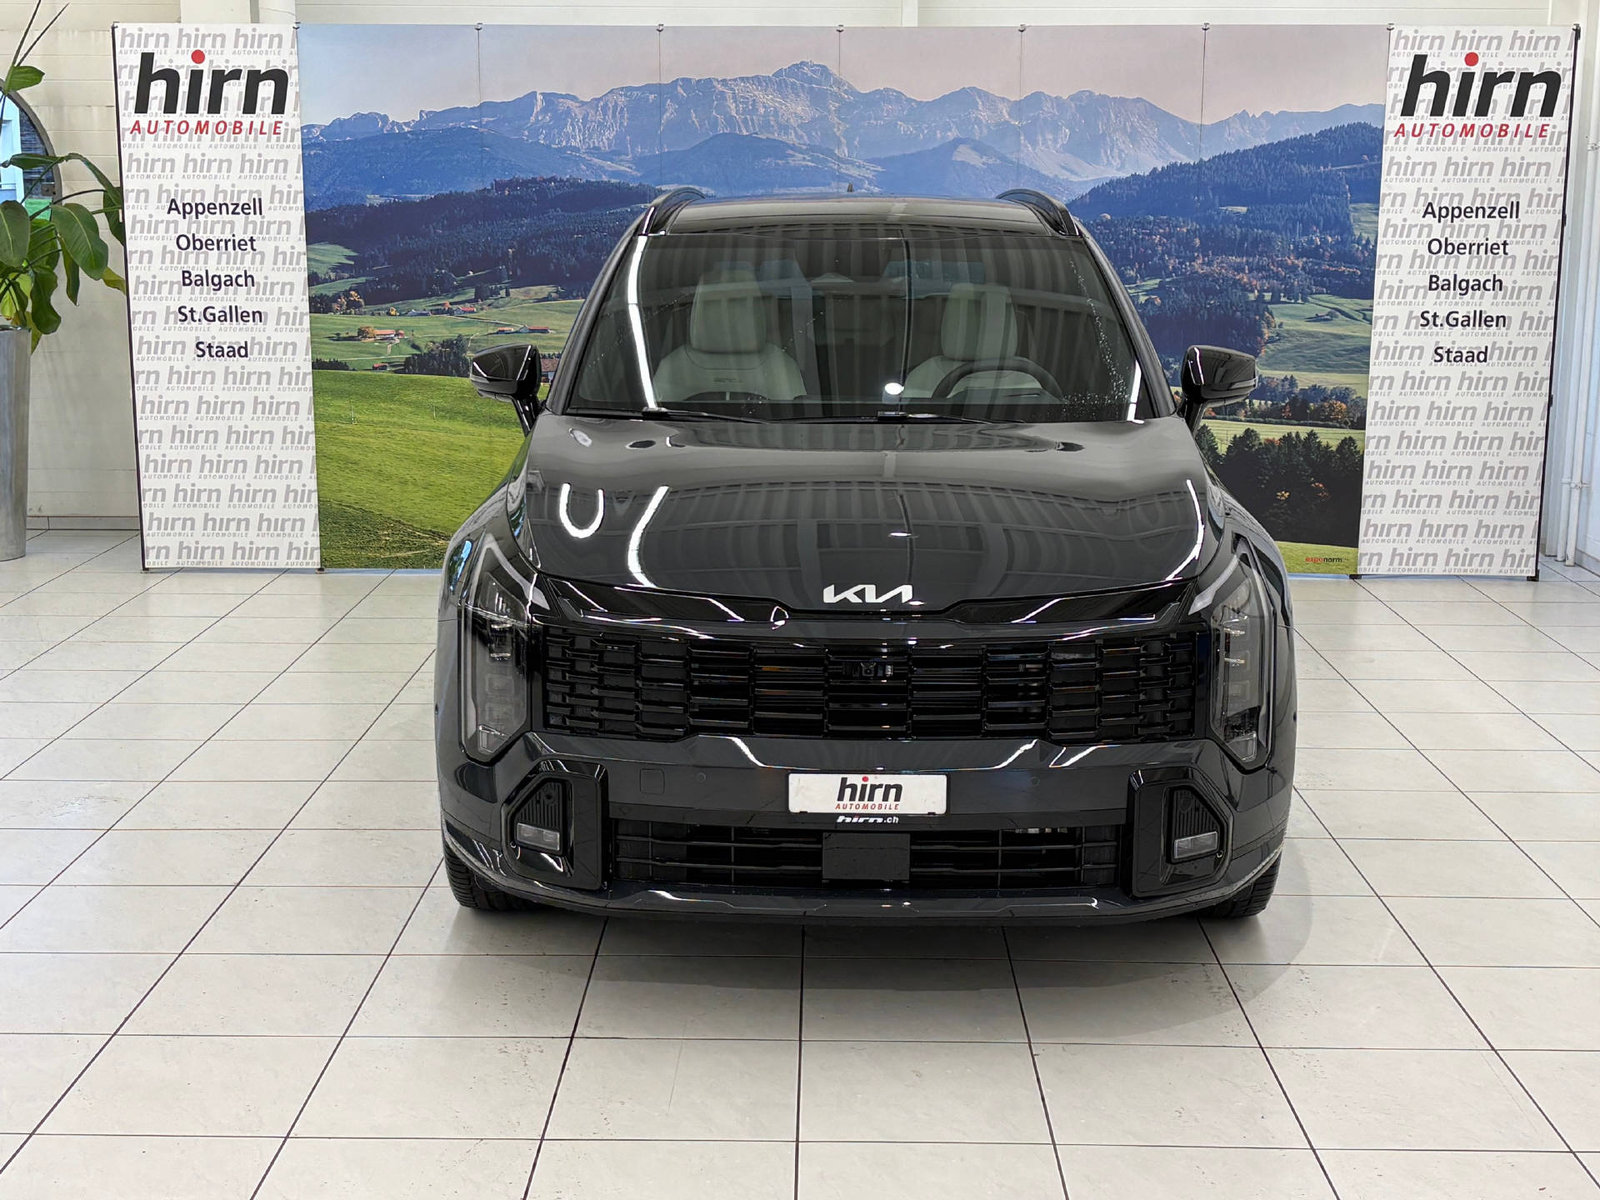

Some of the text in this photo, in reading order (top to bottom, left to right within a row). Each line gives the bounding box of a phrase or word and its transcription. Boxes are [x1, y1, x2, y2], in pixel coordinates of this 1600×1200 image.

[120, 28, 283, 48] hirn hirn hirn
[1394, 29, 1561, 51] hirn hirn hirn
[134, 49, 289, 115] hirn
[1400, 52, 1562, 117] hirn
[130, 120, 283, 135] AUTOMOBILE
[1394, 123, 1550, 138] AUTOMOBILE
[127, 153, 288, 173] hirn hirn hirn
[1386, 156, 1551, 176] hirn hirn hirn
[167, 197, 263, 219] Appenzell
[1422, 201, 1520, 223] Appenzell
[176, 234, 257, 252] Oberriet
[1427, 237, 1509, 255] Oberriet
[181, 270, 255, 292] Balgach
[1428, 274, 1503, 296] Balgach
[178, 305, 263, 323] St.Gallen
[1420, 310, 1507, 328] St.Gallen
[137, 335, 297, 355] hirn hirn
[195, 341, 249, 358] Staad
[1374, 340, 1538, 360] hirn hirn
[1433, 346, 1488, 363] Staad
[167, 365, 216, 385] hirn
[223, 365, 271, 385] hirn
[1401, 370, 1451, 391] hirn
[1458, 370, 1508, 391] hirn
[140, 395, 300, 415] hirn hirn hirn
[1371, 400, 1533, 420] hirn hirn hirn
[170, 425, 218, 444] hirn
[226, 425, 274, 444] hirn
[1397, 430, 1447, 450] hirn
[1454, 430, 1503, 450] hirn
[144, 454, 301, 474] hirn hirn hirn
[1367, 460, 1529, 480] hirn hirn hirn
[174, 483, 221, 502] hirn
[228, 483, 277, 502] hirn
[1393, 489, 1442, 509] hirn
[1449, 489, 1499, 509] hirn
[177, 541, 225, 560] hirn
[232, 541, 280, 560] hirn
[1389, 547, 1438, 567] hirn
[1445, 547, 1494, 567] hirn
[823, 584, 913, 604] KIA
[837, 776, 903, 802] hirn
[836, 815, 899, 824] hirn.ch
